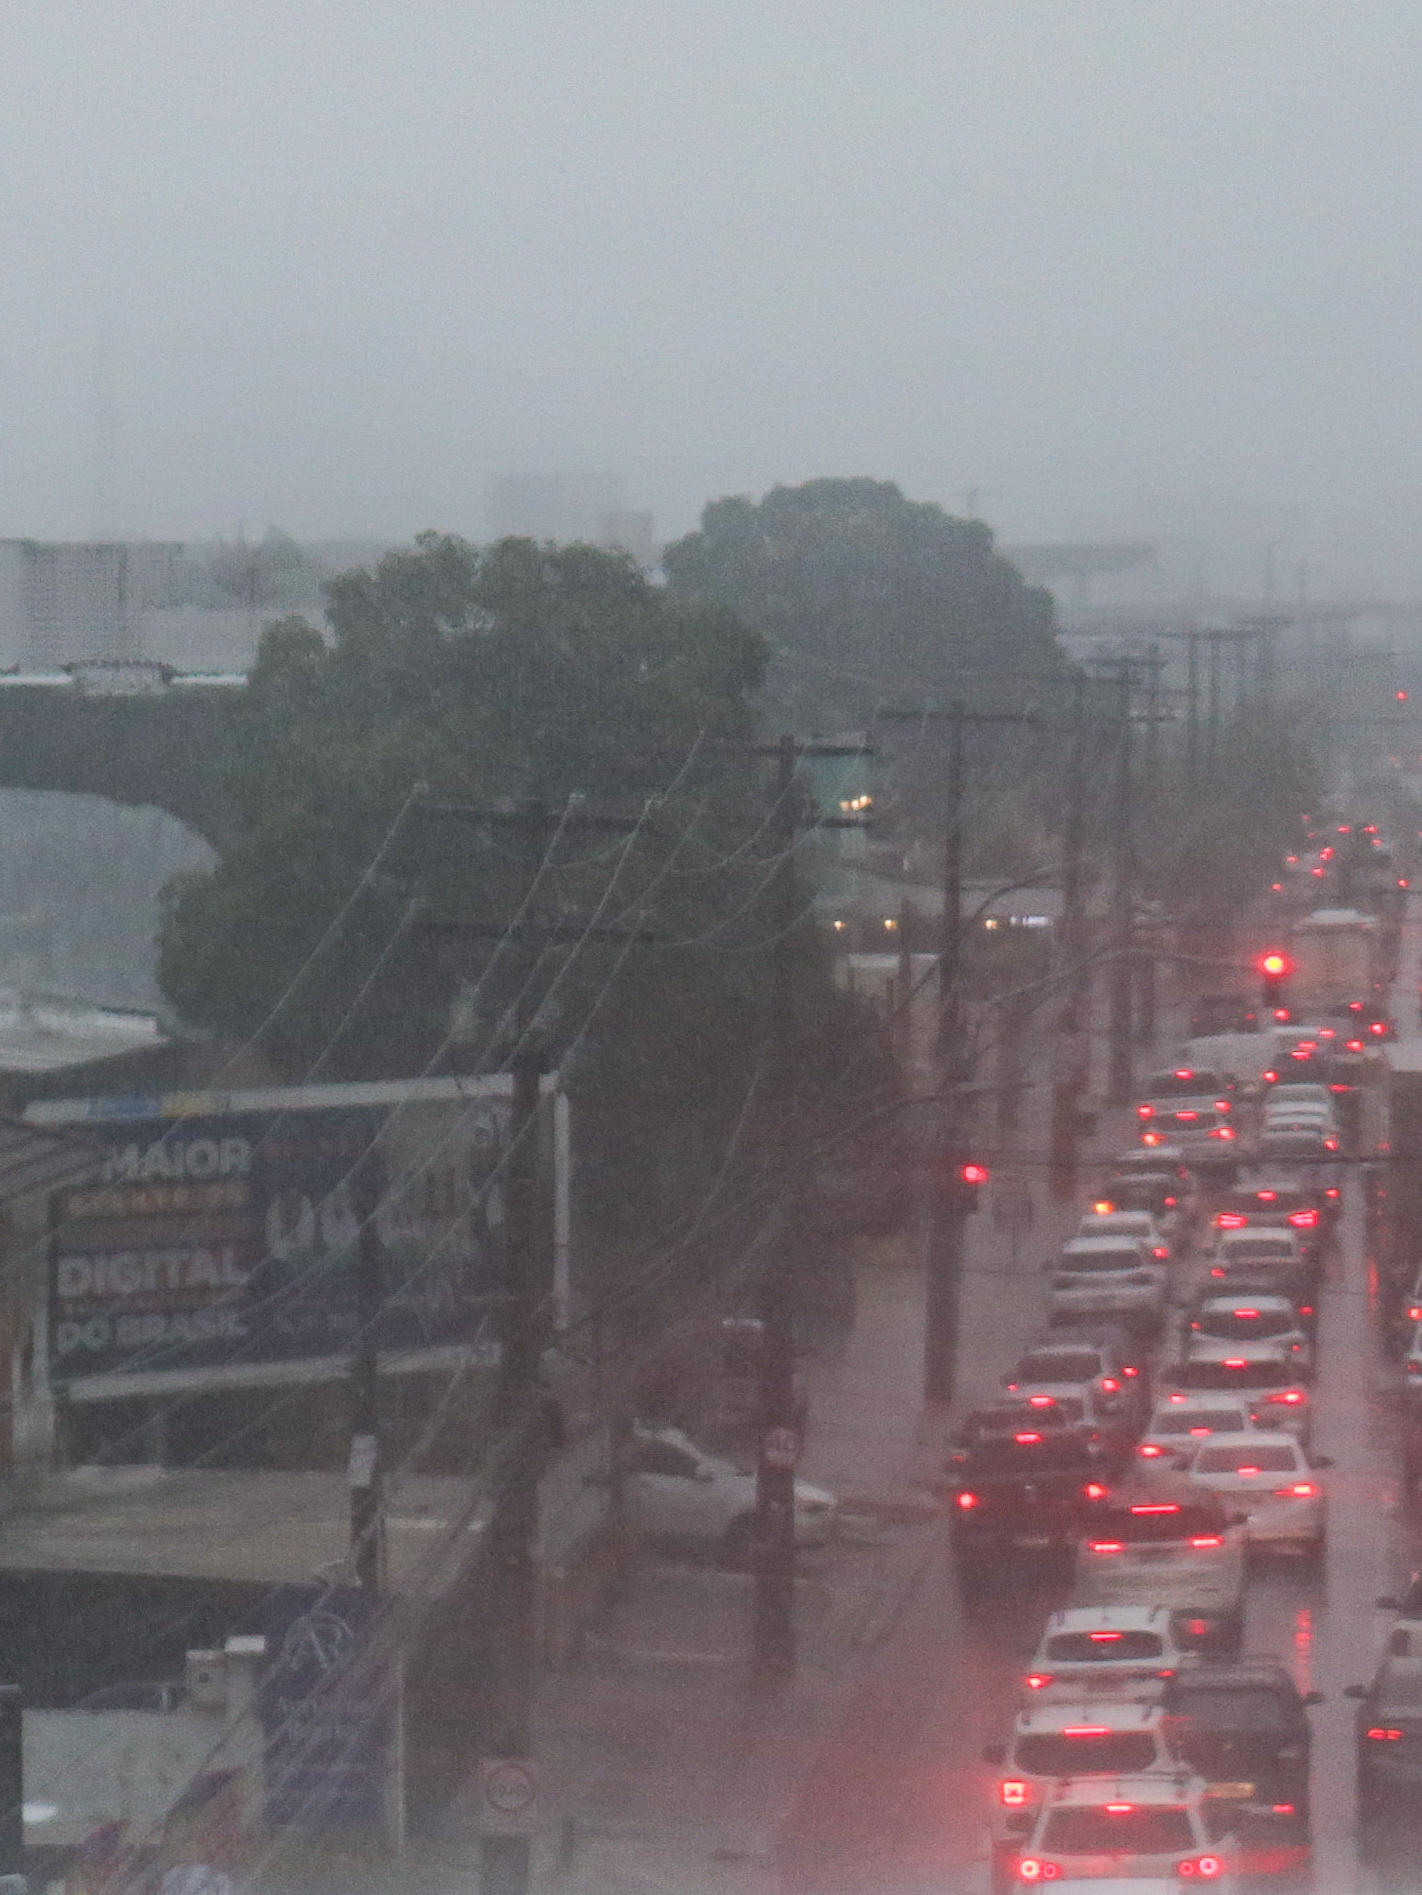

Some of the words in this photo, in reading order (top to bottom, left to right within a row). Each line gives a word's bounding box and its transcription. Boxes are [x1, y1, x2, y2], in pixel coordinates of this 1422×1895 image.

[101, 1137, 251, 1181] MAIOR
[57, 1246, 249, 1298] DIGITAL
[57, 1317, 110, 1354] DO
[116, 1309, 248, 1348] BRASIL
